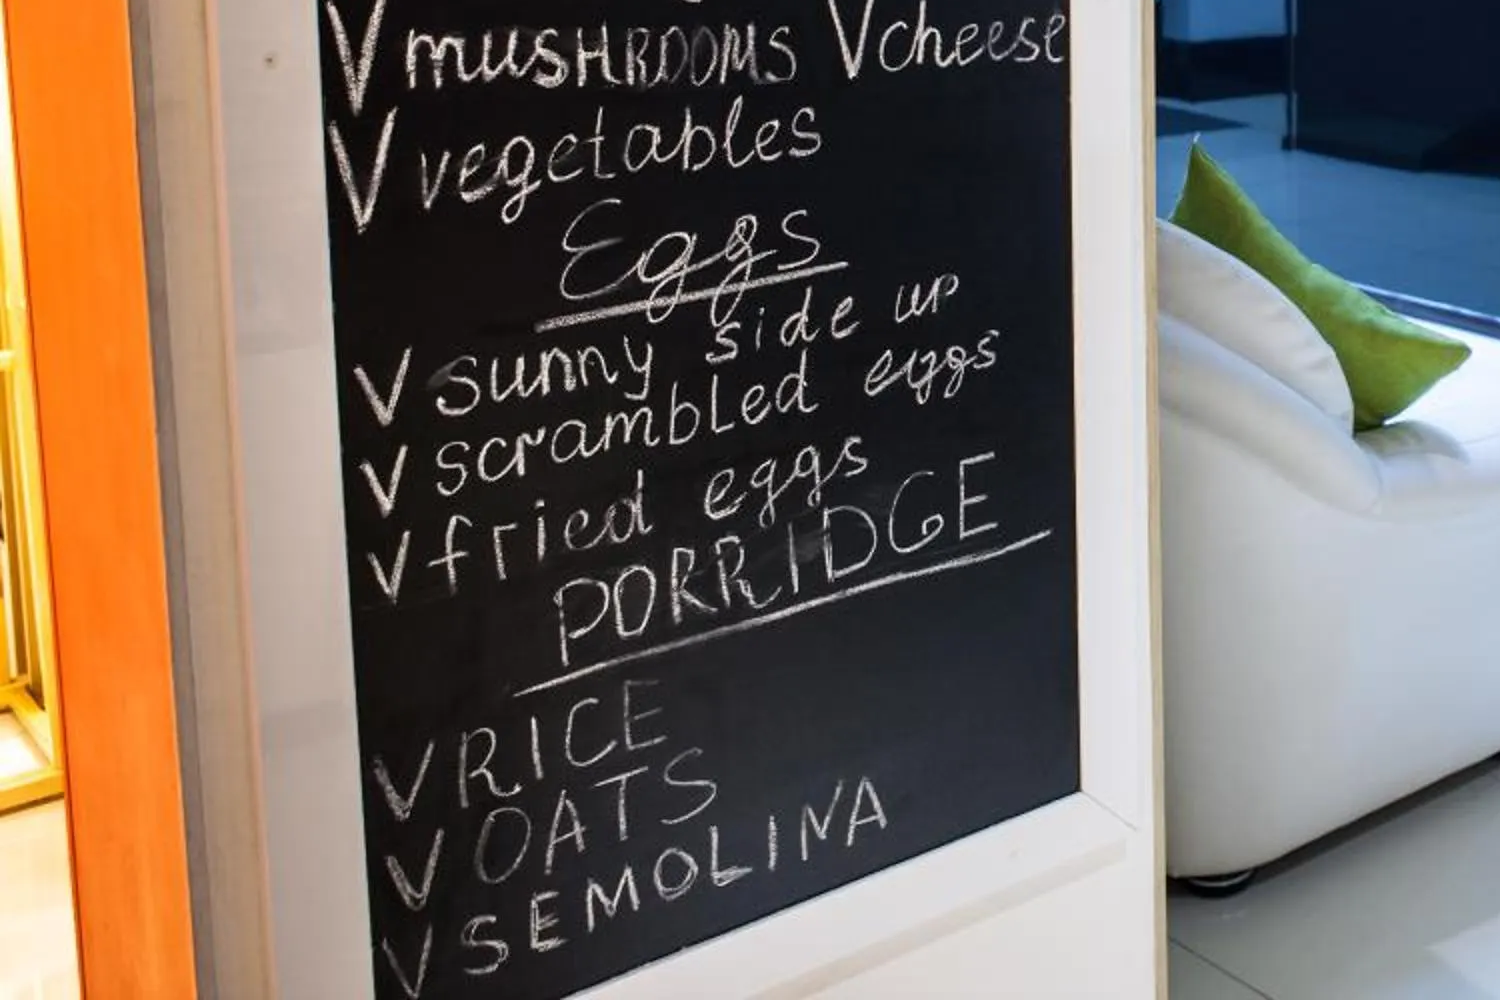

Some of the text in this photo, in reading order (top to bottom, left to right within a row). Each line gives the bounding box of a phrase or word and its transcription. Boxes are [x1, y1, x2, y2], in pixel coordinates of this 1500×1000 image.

[878, 0, 1067, 73] cheese
[419, 95, 823, 225] vegetables
[560, 199, 820, 326] Eggs
[436, 273, 959, 416] sunny side up
[863, 329, 1000, 405] eggs
[426, 435, 870, 596] fried eggs
[552, 451, 1000, 667] PORRIDGE
[458, 680, 668, 809] RICE
[460, 776, 888, 975] SEMOLINA
[474, 747, 720, 884] OATS
